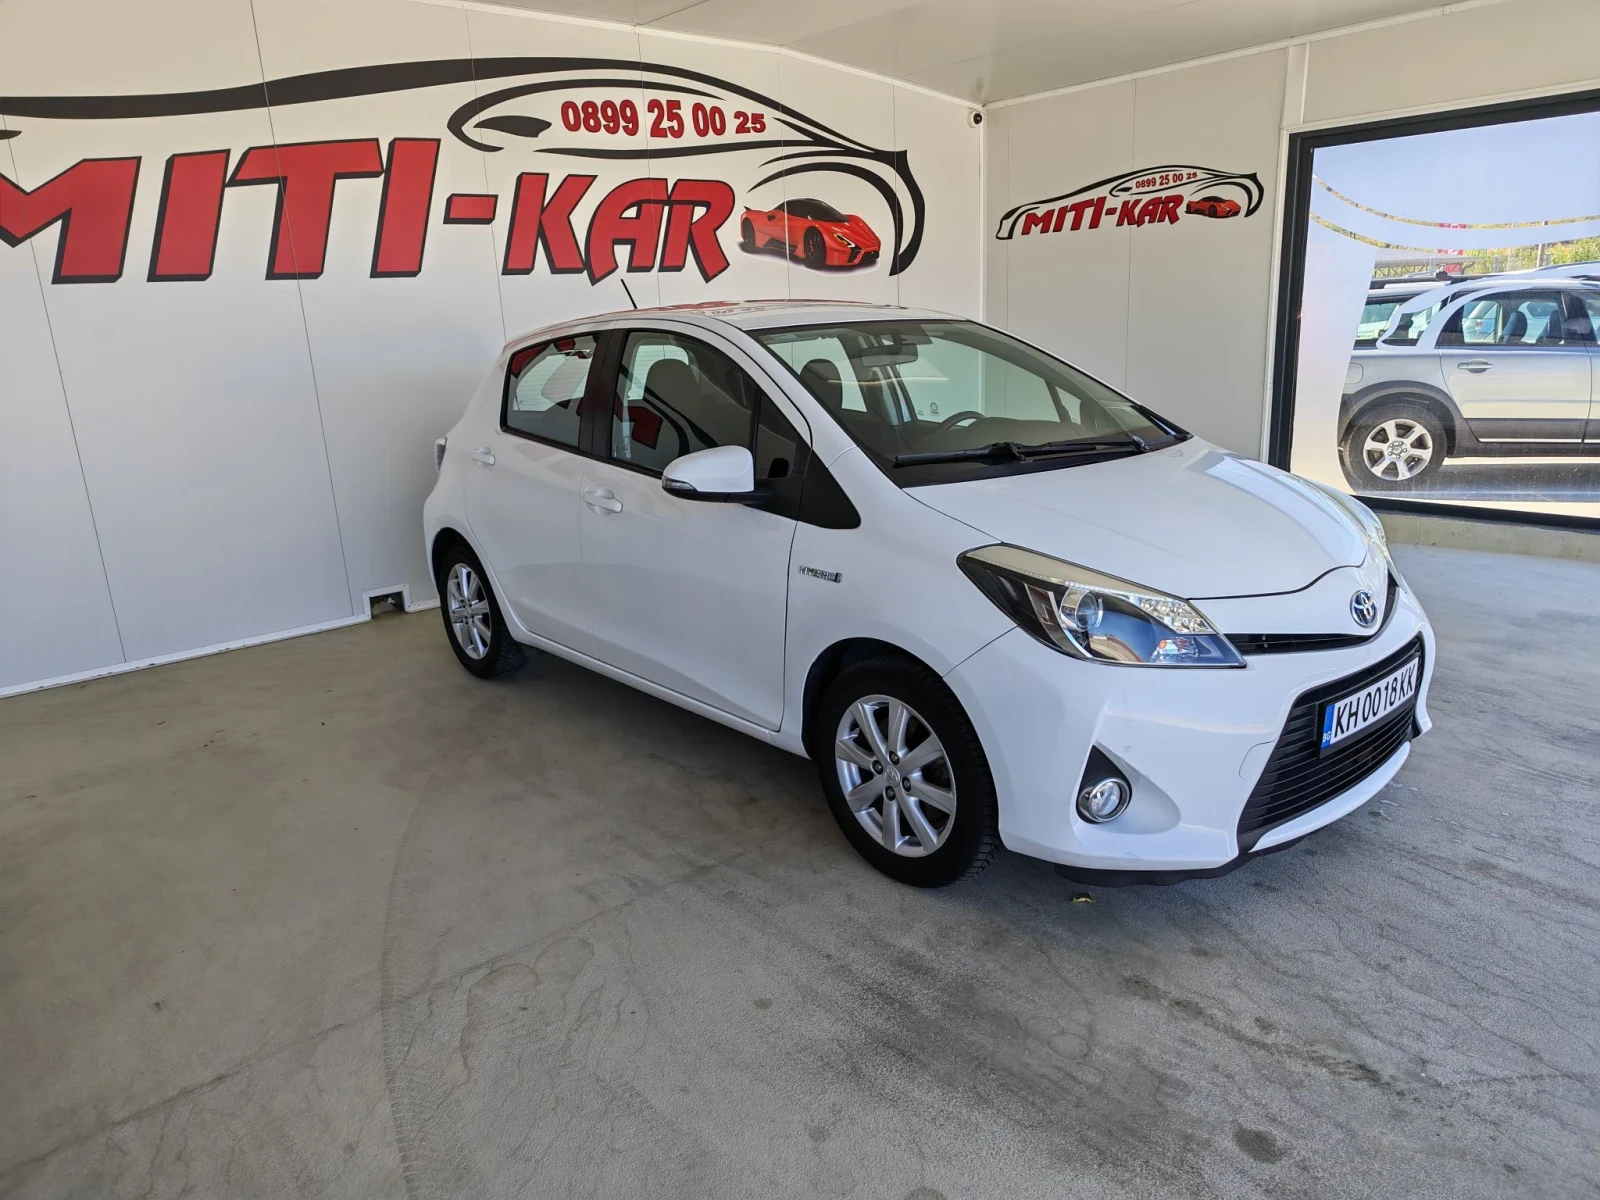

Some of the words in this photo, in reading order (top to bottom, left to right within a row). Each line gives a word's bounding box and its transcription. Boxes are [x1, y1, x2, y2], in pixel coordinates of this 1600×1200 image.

[560, 100, 640, 136] 0899
[647, 98, 685, 139] 25
[691, 102, 727, 137] 00
[733, 110, 767, 134] 25
[1135, 177, 1157, 189] 0899
[1159, 174, 1171, 186] 25
[1172, 173, 1184, 183] 00
[1186, 171, 1198, 180] 25
[1020, 194, 1184, 235] MITI-KAR
[1323, 732, 1331, 742] BG
